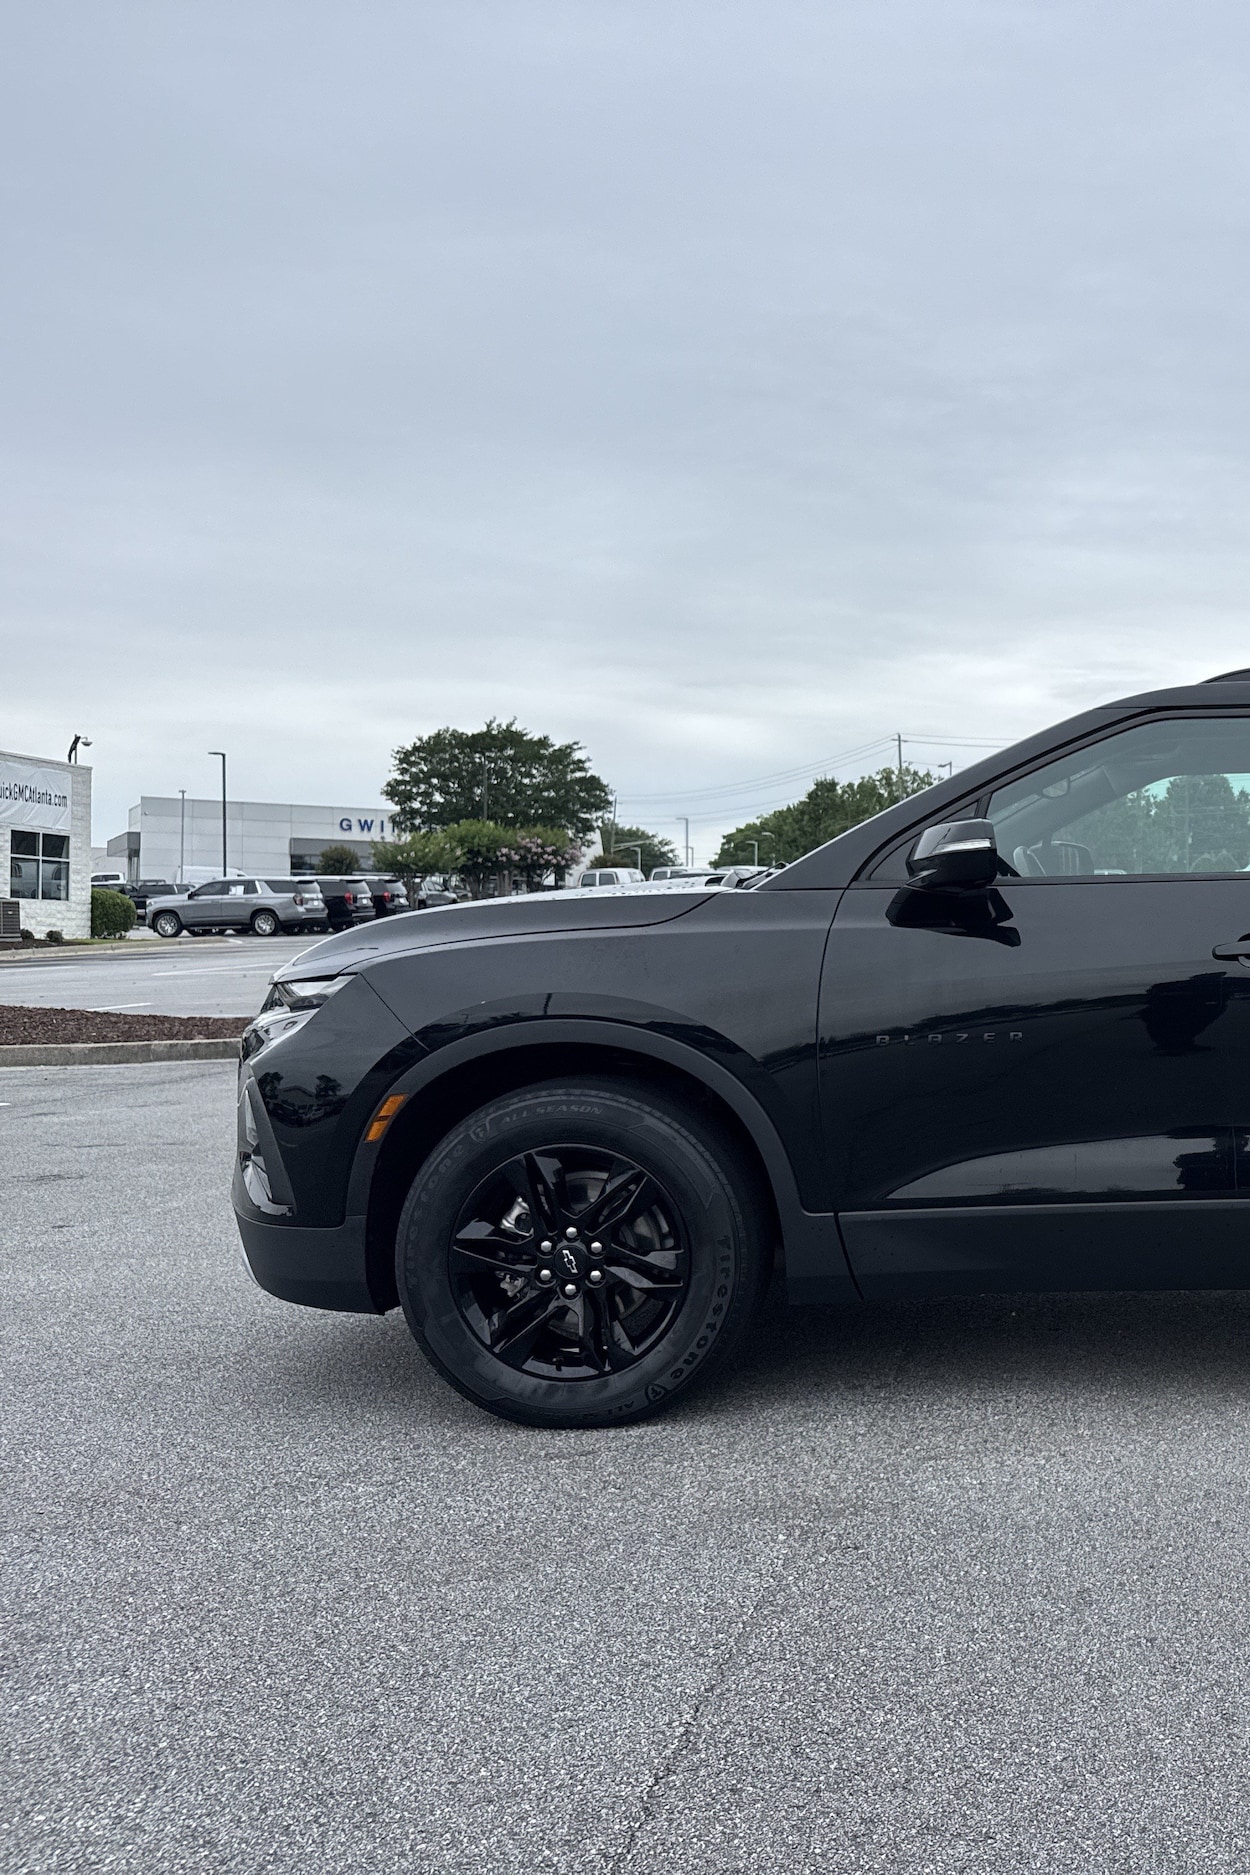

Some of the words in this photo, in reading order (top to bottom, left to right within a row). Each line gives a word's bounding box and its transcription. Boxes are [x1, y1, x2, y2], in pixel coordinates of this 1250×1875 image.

[875, 1031, 1023, 1046] BLAZER
[535, 1104, 604, 1115] SEASON
[669, 1234, 732, 1380] Firestone
